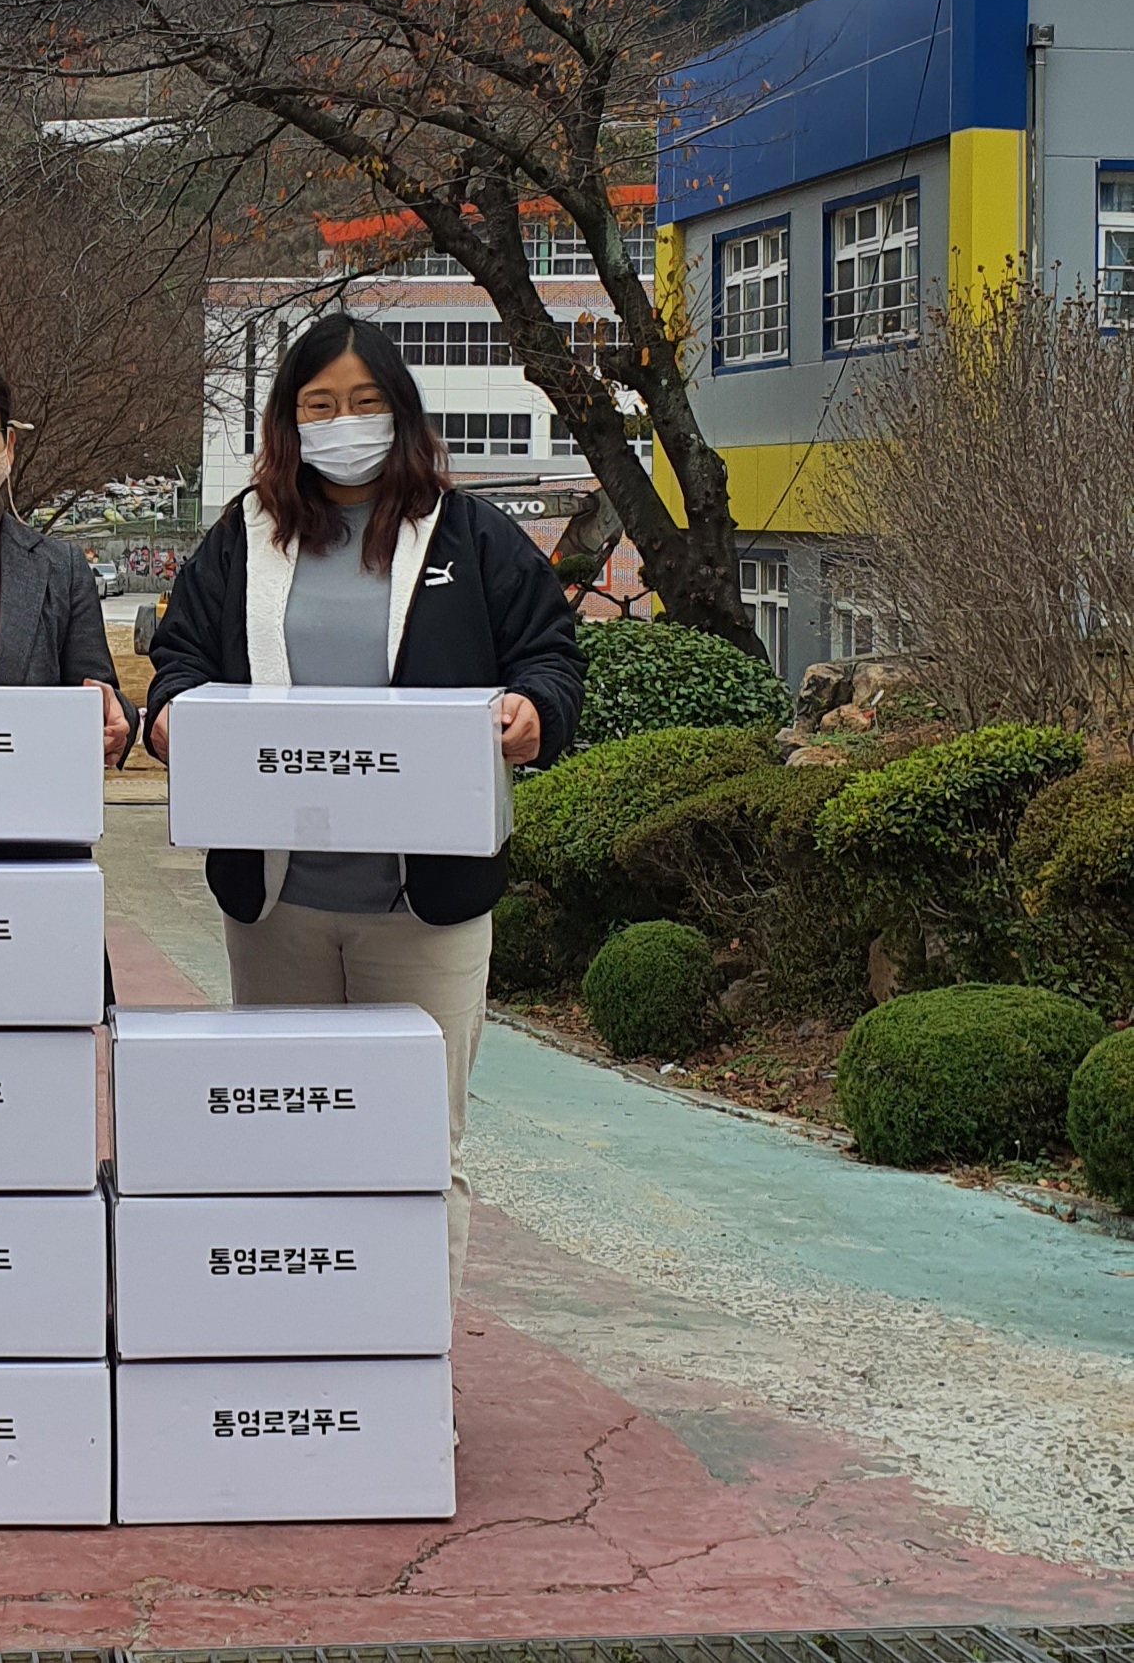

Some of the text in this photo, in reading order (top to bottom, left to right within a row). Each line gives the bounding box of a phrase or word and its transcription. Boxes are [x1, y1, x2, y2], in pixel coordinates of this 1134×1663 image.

[256, 748, 402, 777] 통영로컬푸드
[207, 1086, 357, 1115] 통영로컬푸드
[208, 1247, 358, 1277] 통영로컬푸드
[212, 1408, 362, 1439] 통영로컬푸드
